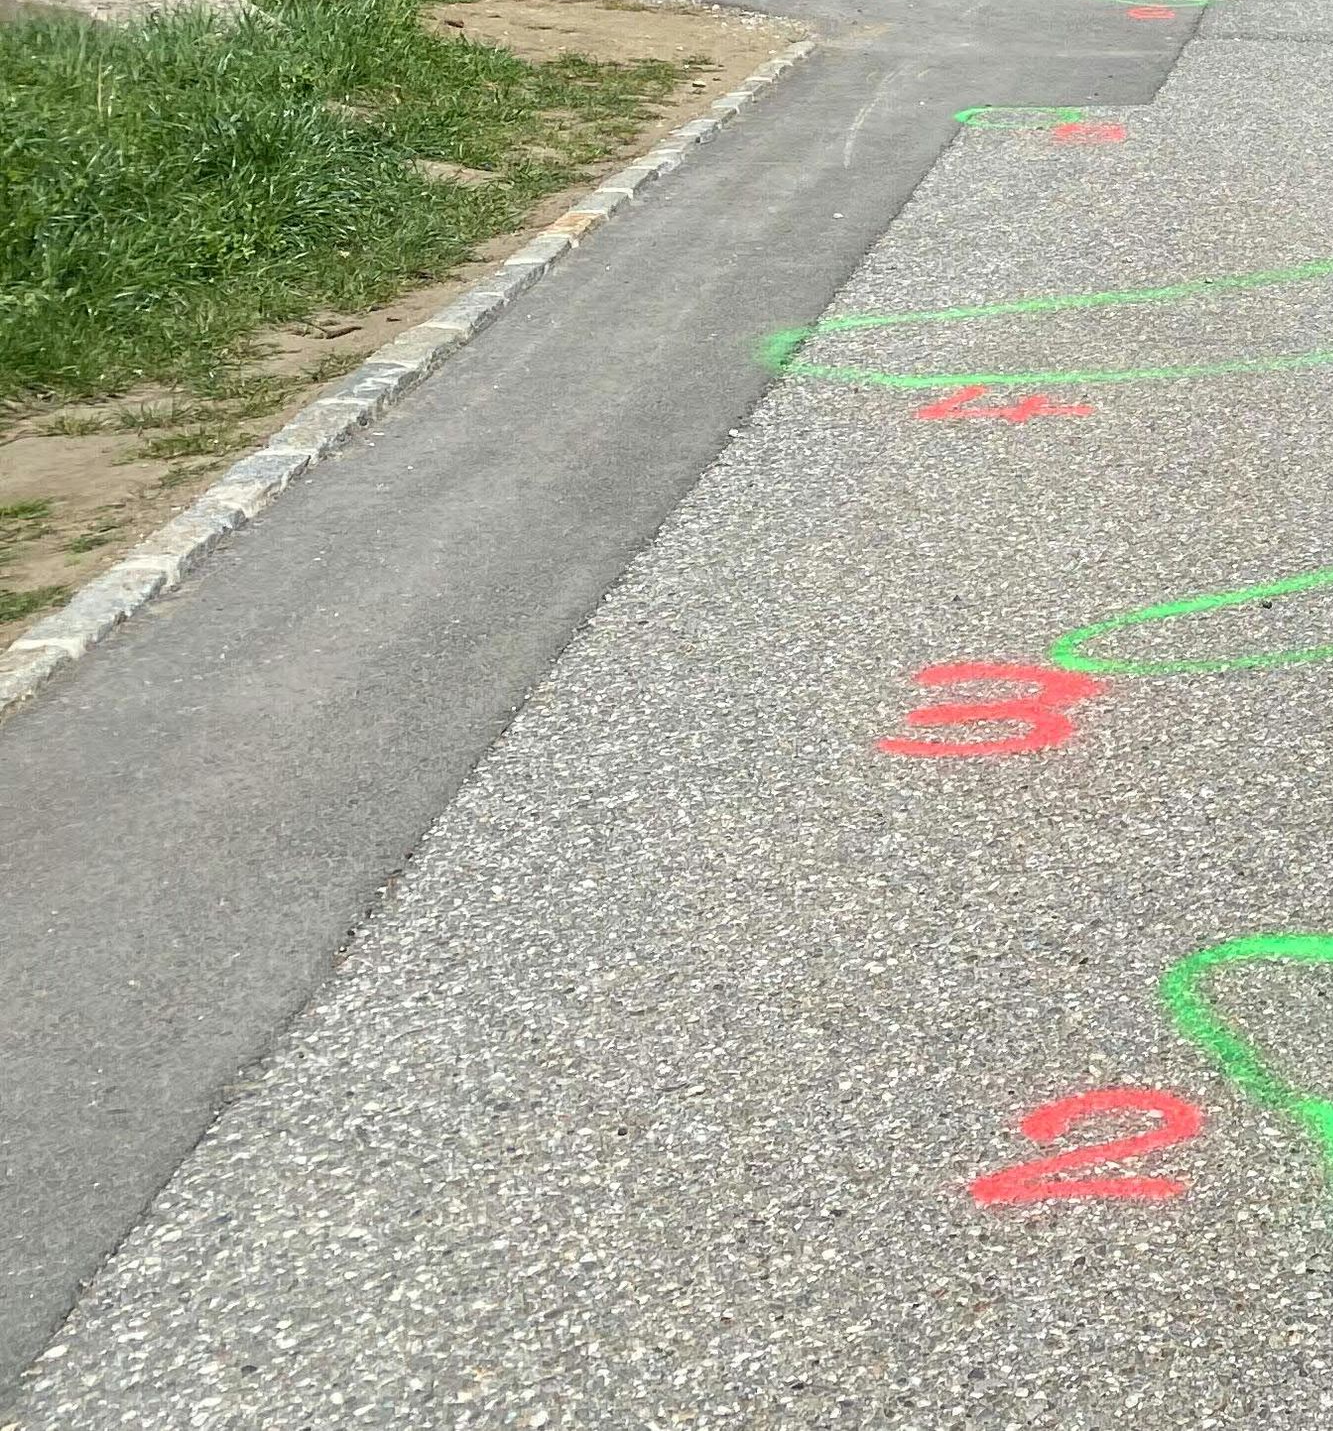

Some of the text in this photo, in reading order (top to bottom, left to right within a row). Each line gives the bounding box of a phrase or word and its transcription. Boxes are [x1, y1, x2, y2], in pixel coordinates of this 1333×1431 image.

[915, 385, 1093, 424] 4
[876, 661, 1108, 758] 3
[967, 1086, 1206, 1207] 2
